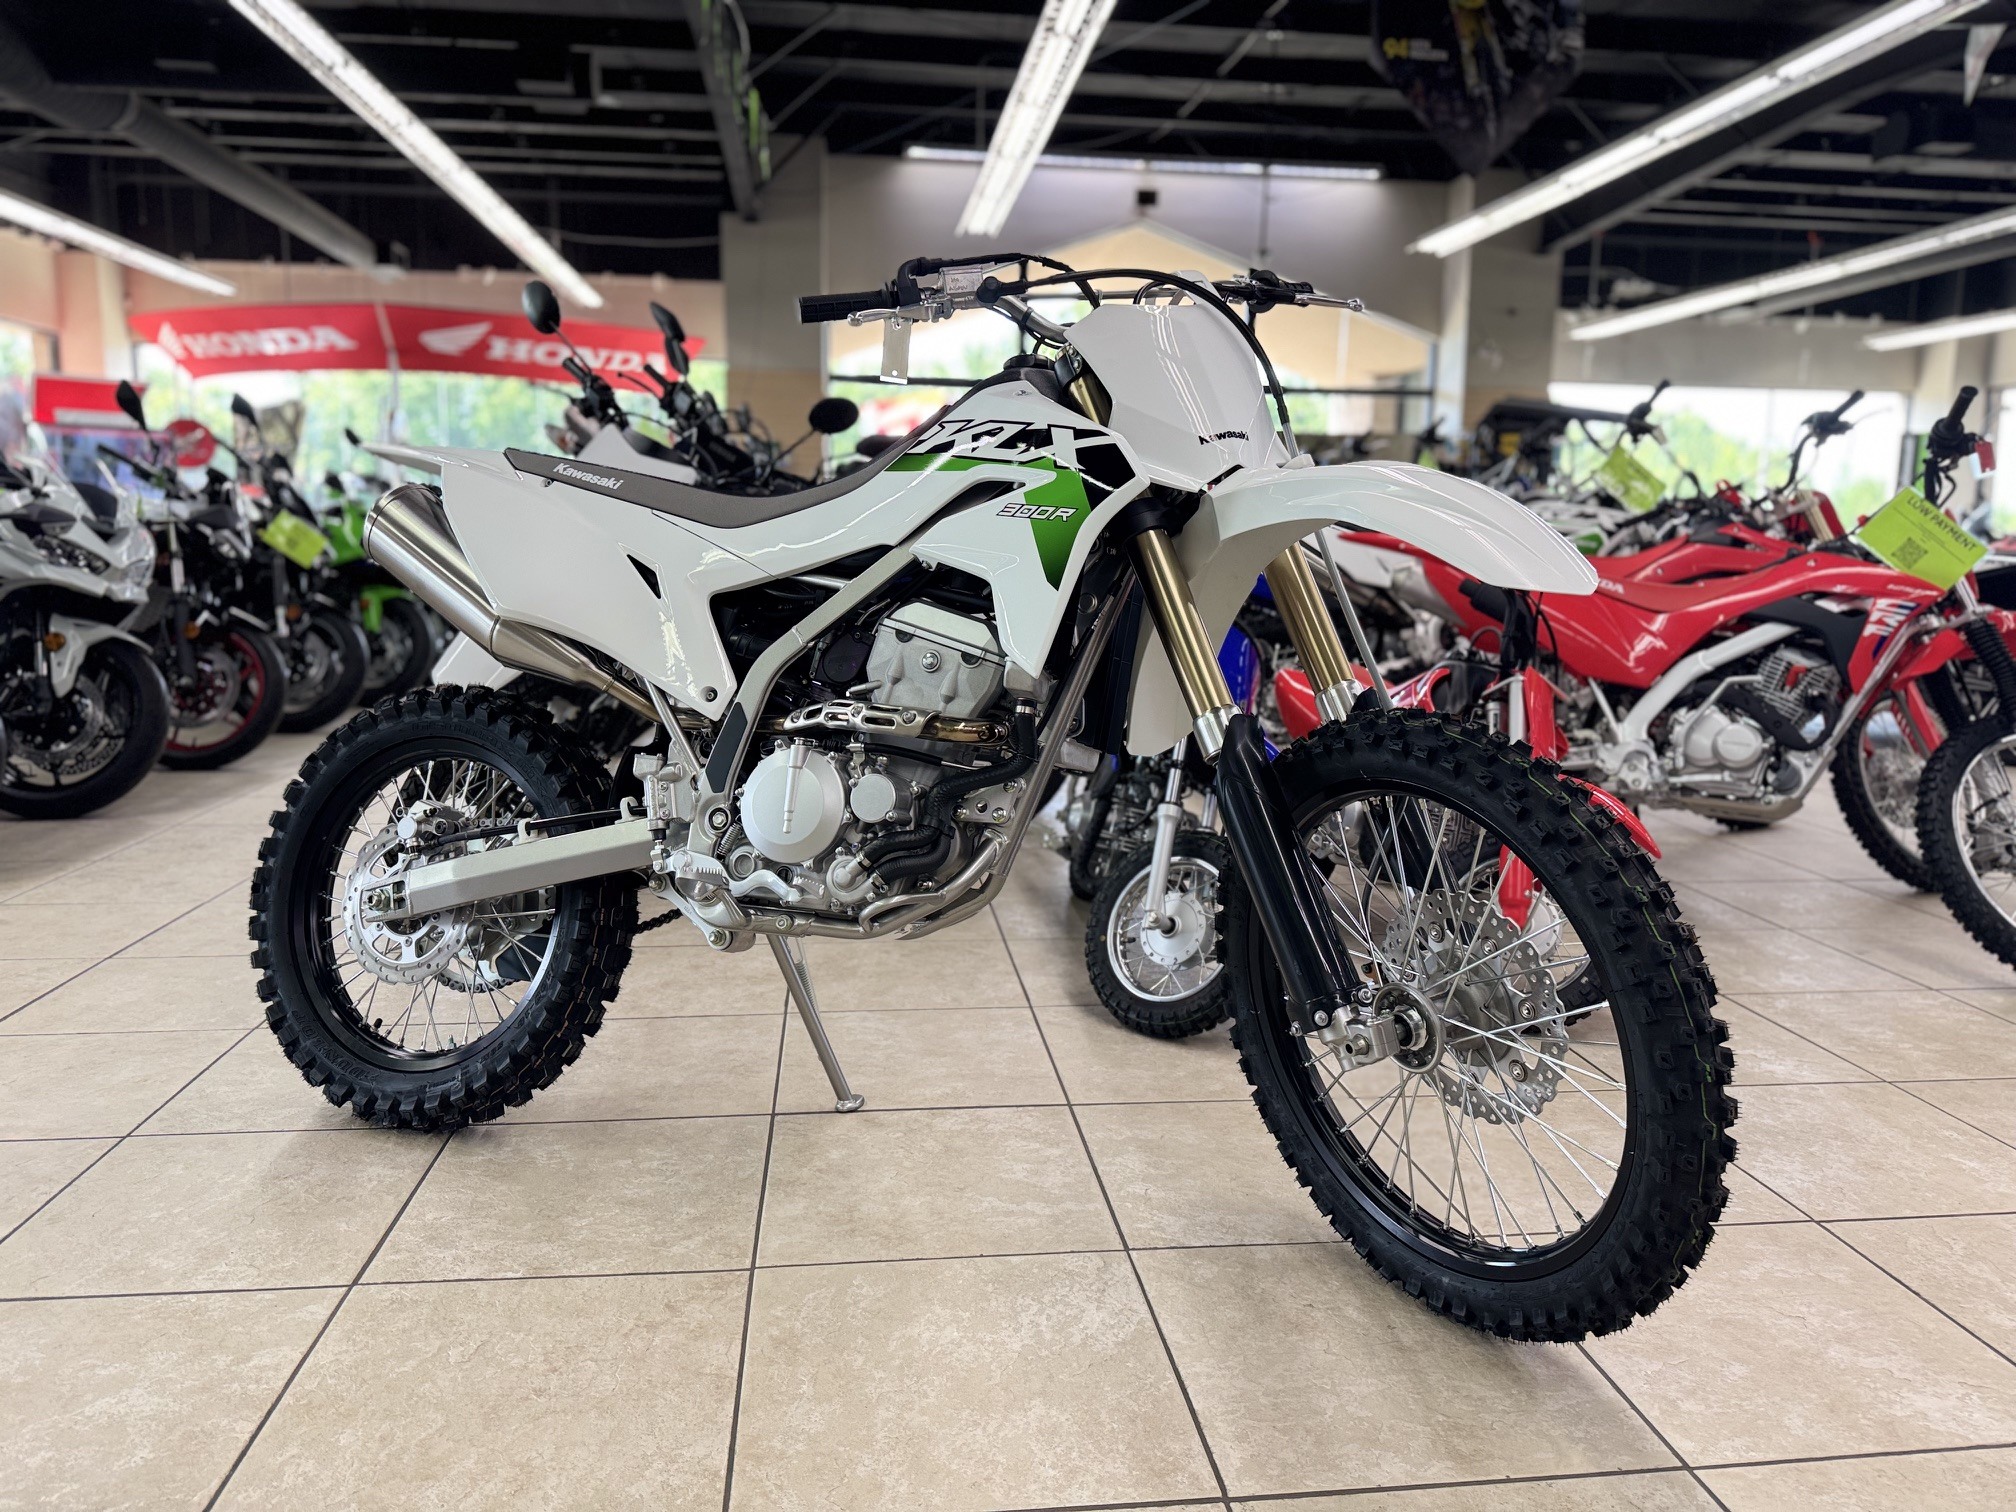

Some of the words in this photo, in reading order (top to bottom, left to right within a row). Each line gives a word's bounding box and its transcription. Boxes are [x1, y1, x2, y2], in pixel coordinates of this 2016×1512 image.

[182, 325, 359, 360] HONDA
[905, 418, 1112, 470] KLX
[553, 463, 624, 489] Kawasaki
[996, 502, 1078, 522] 300R
